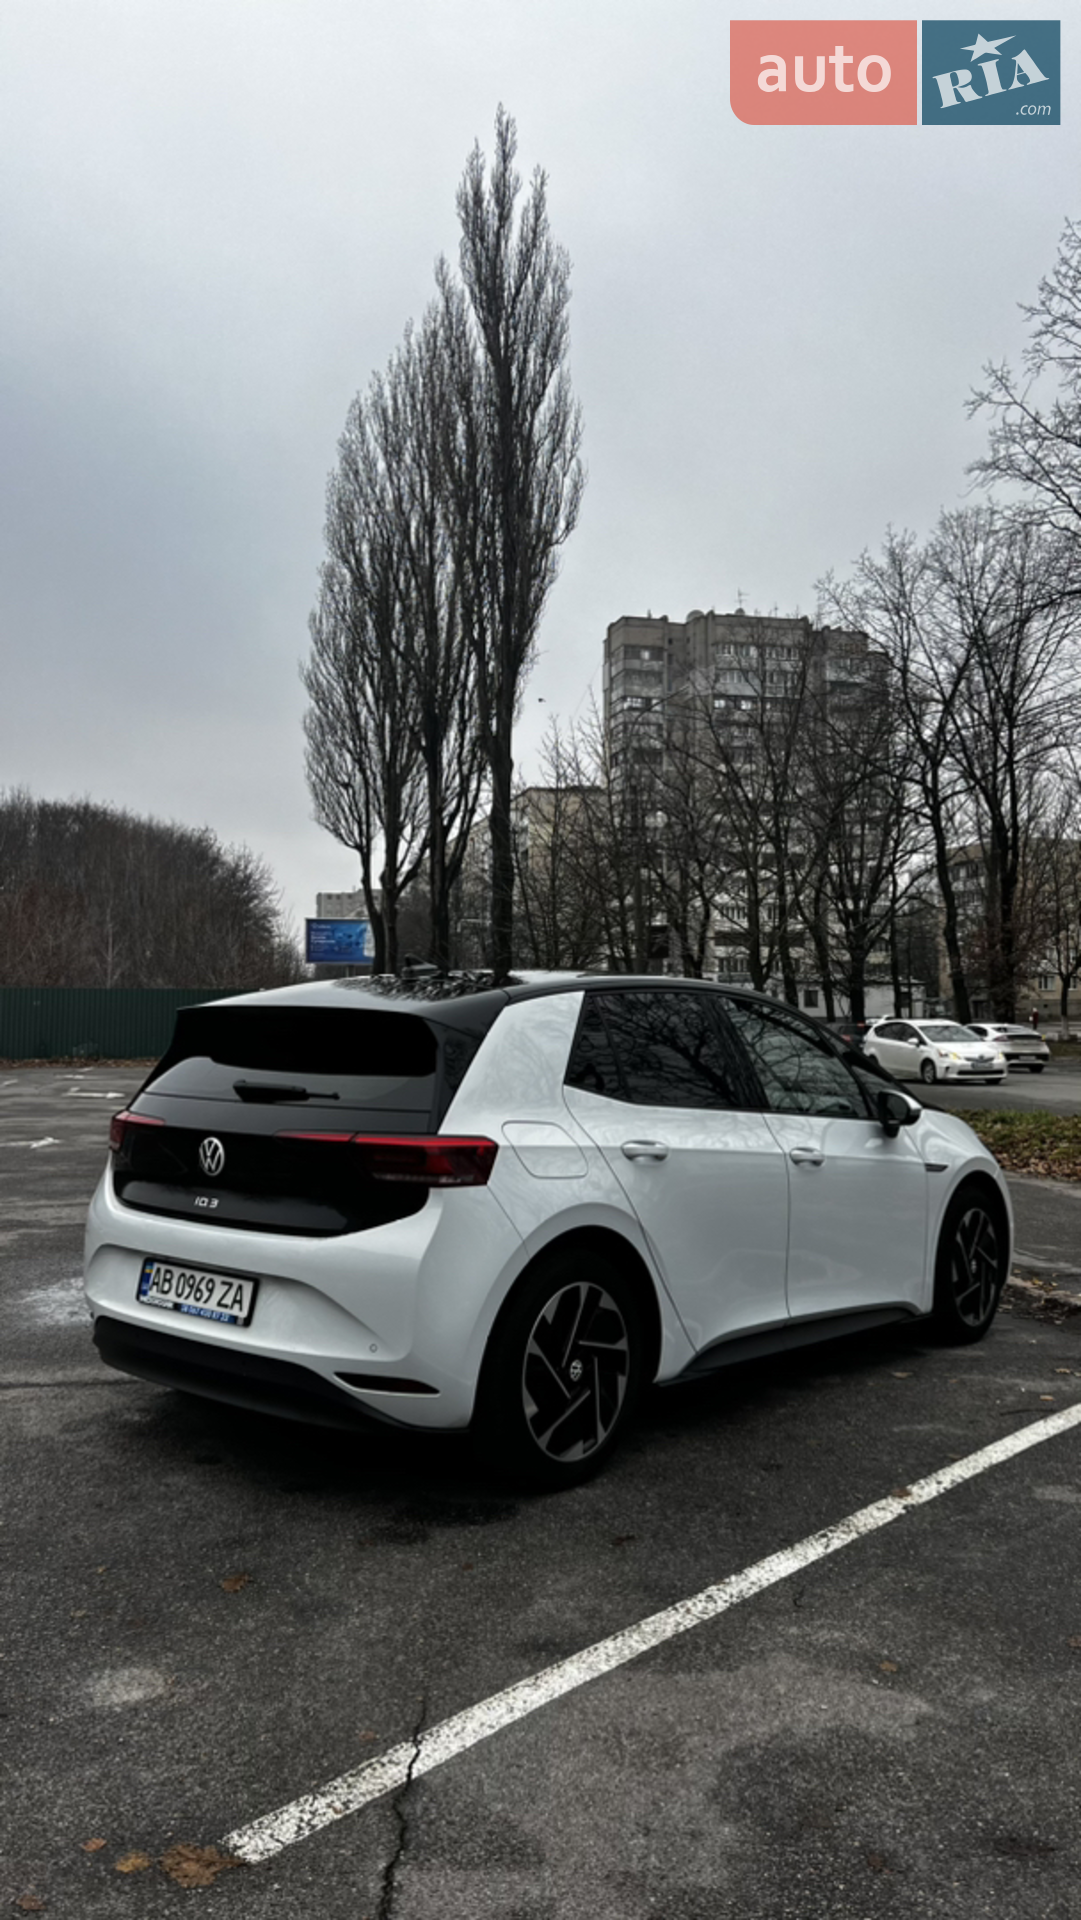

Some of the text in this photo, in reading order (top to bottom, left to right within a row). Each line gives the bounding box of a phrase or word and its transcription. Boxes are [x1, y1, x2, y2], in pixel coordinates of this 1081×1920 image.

[149, 1266, 174, 1295] AB
[175, 1272, 216, 1304] 0969
[216, 1281, 243, 1312] ZA
